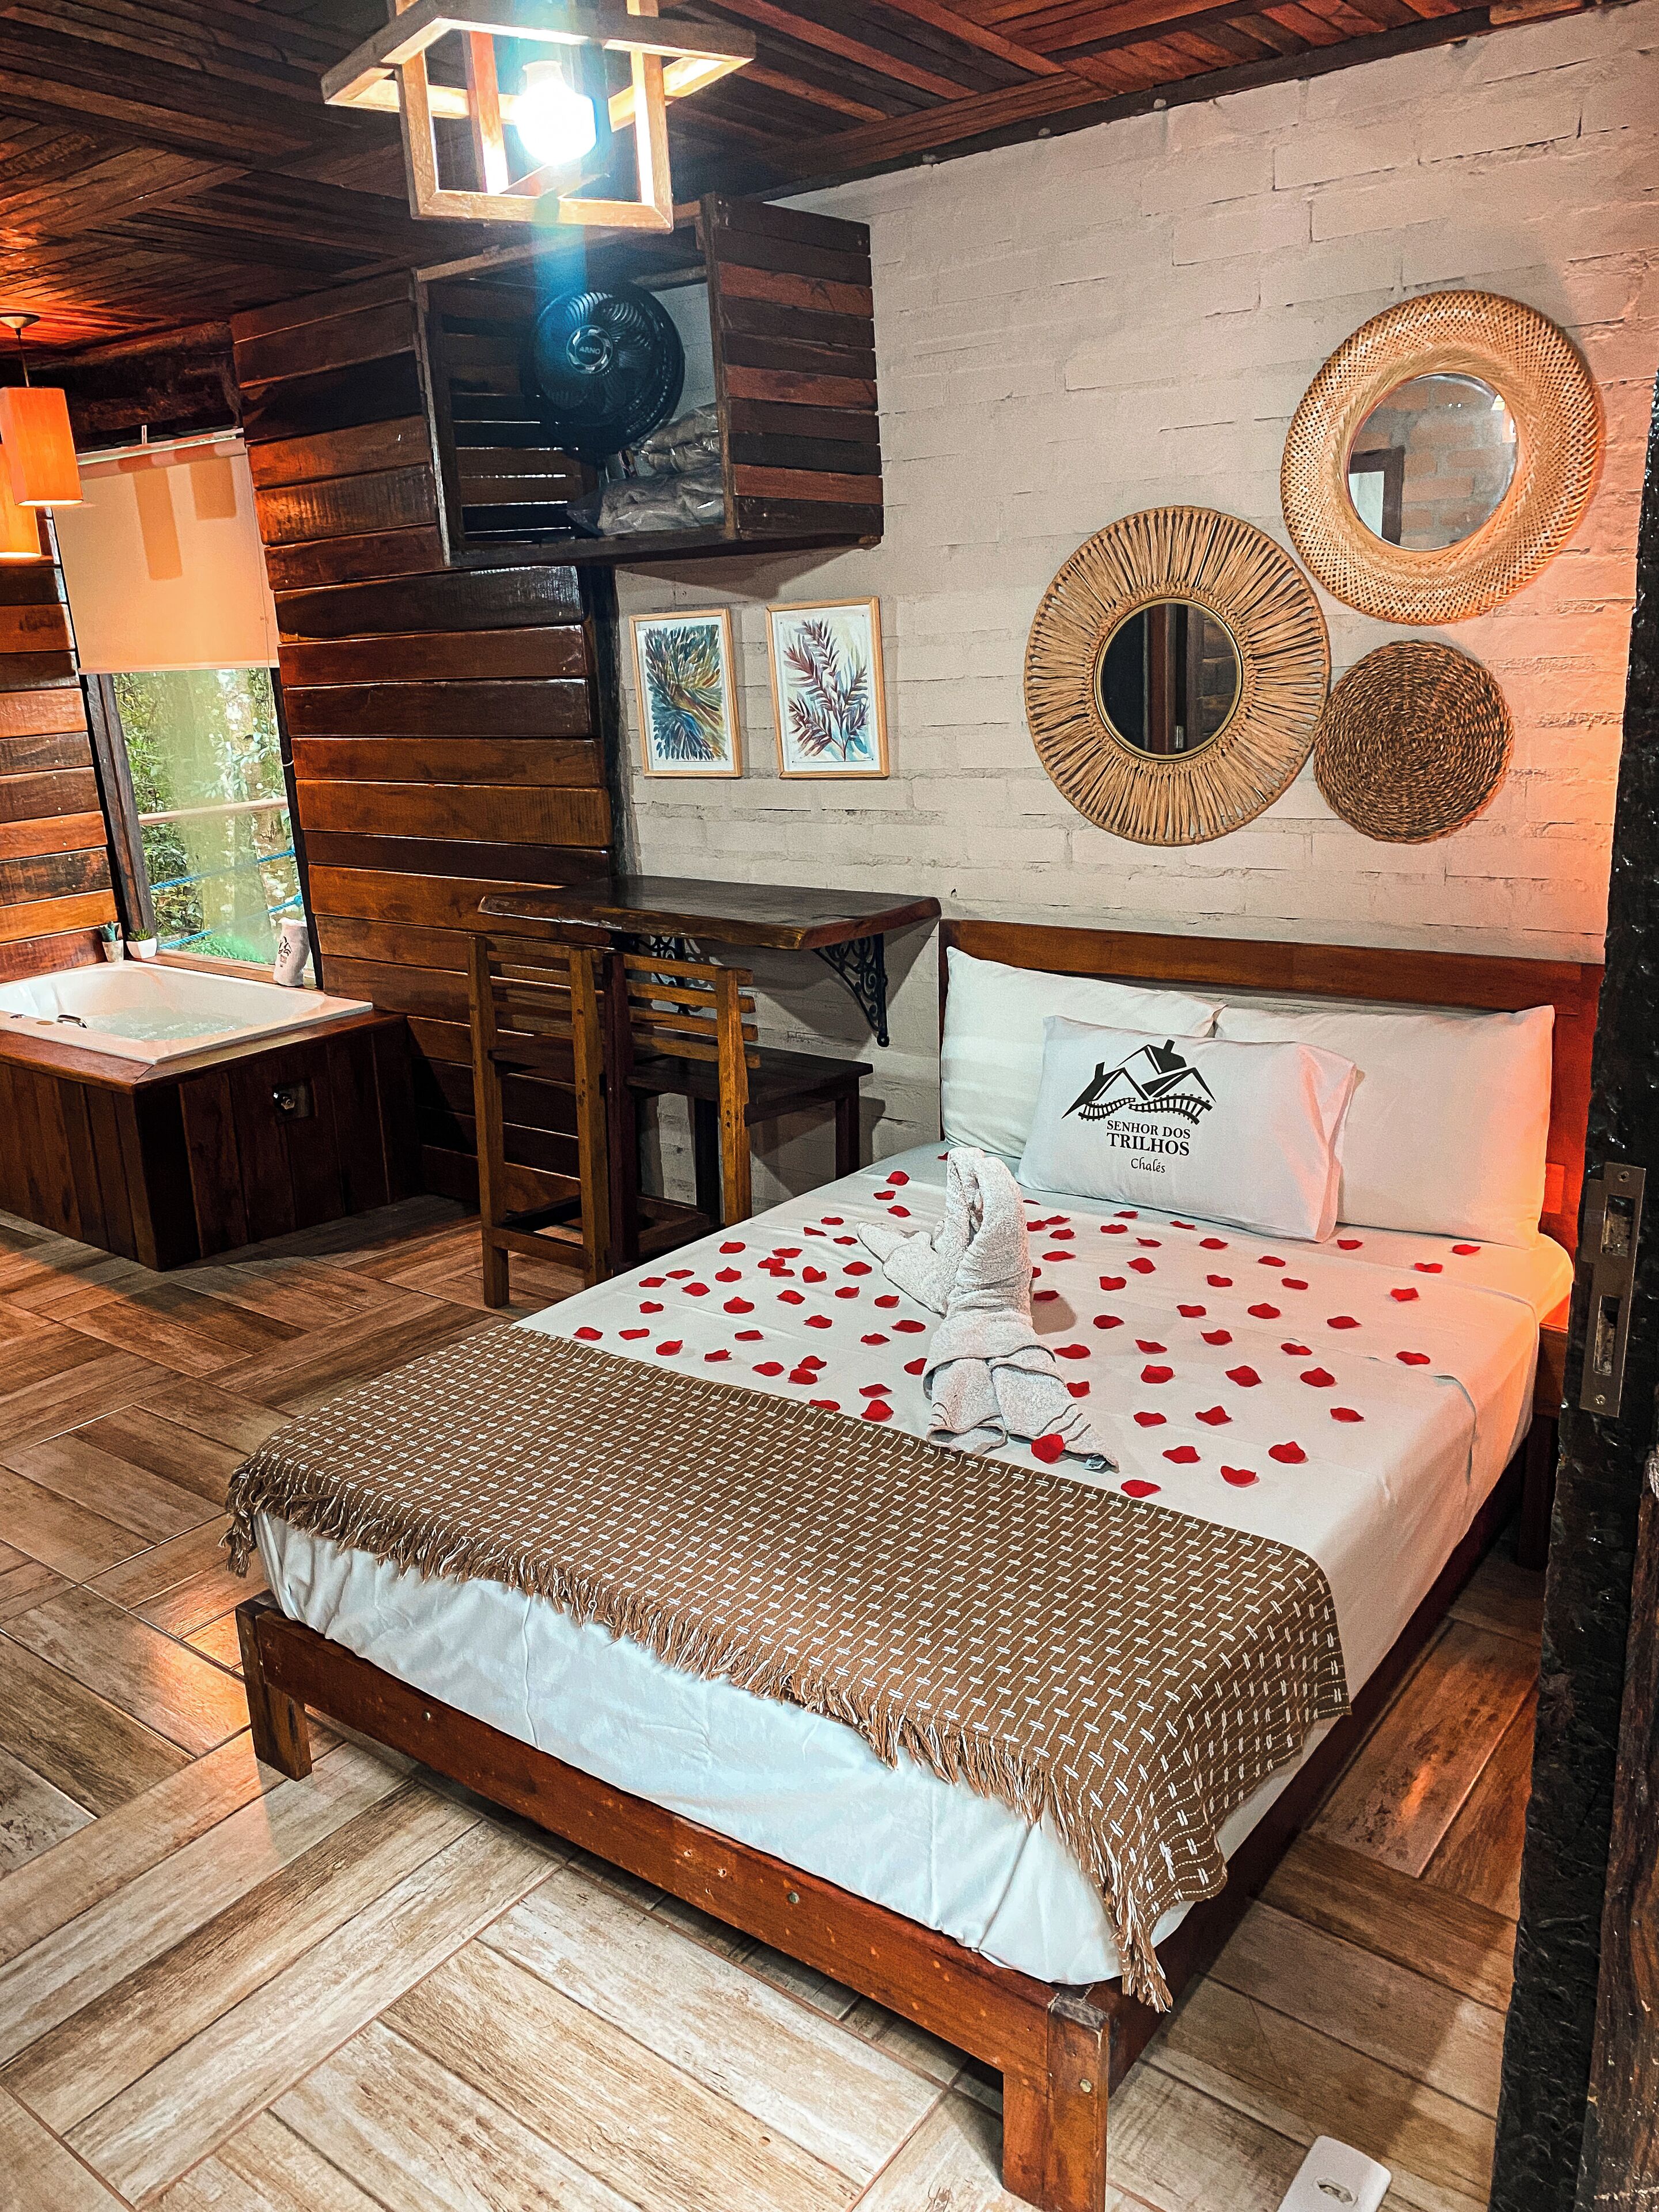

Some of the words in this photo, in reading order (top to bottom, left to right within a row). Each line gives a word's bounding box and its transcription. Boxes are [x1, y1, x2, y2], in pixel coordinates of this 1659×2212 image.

[579, 346, 600, 354] ARNO
[1107, 1120, 1158, 1135] SENHOR
[1162, 1126, 1190, 1139] DOS
[1106, 1132, 1190, 1156] TRILHOS
[1131, 1157, 1165, 1173] Chalés
